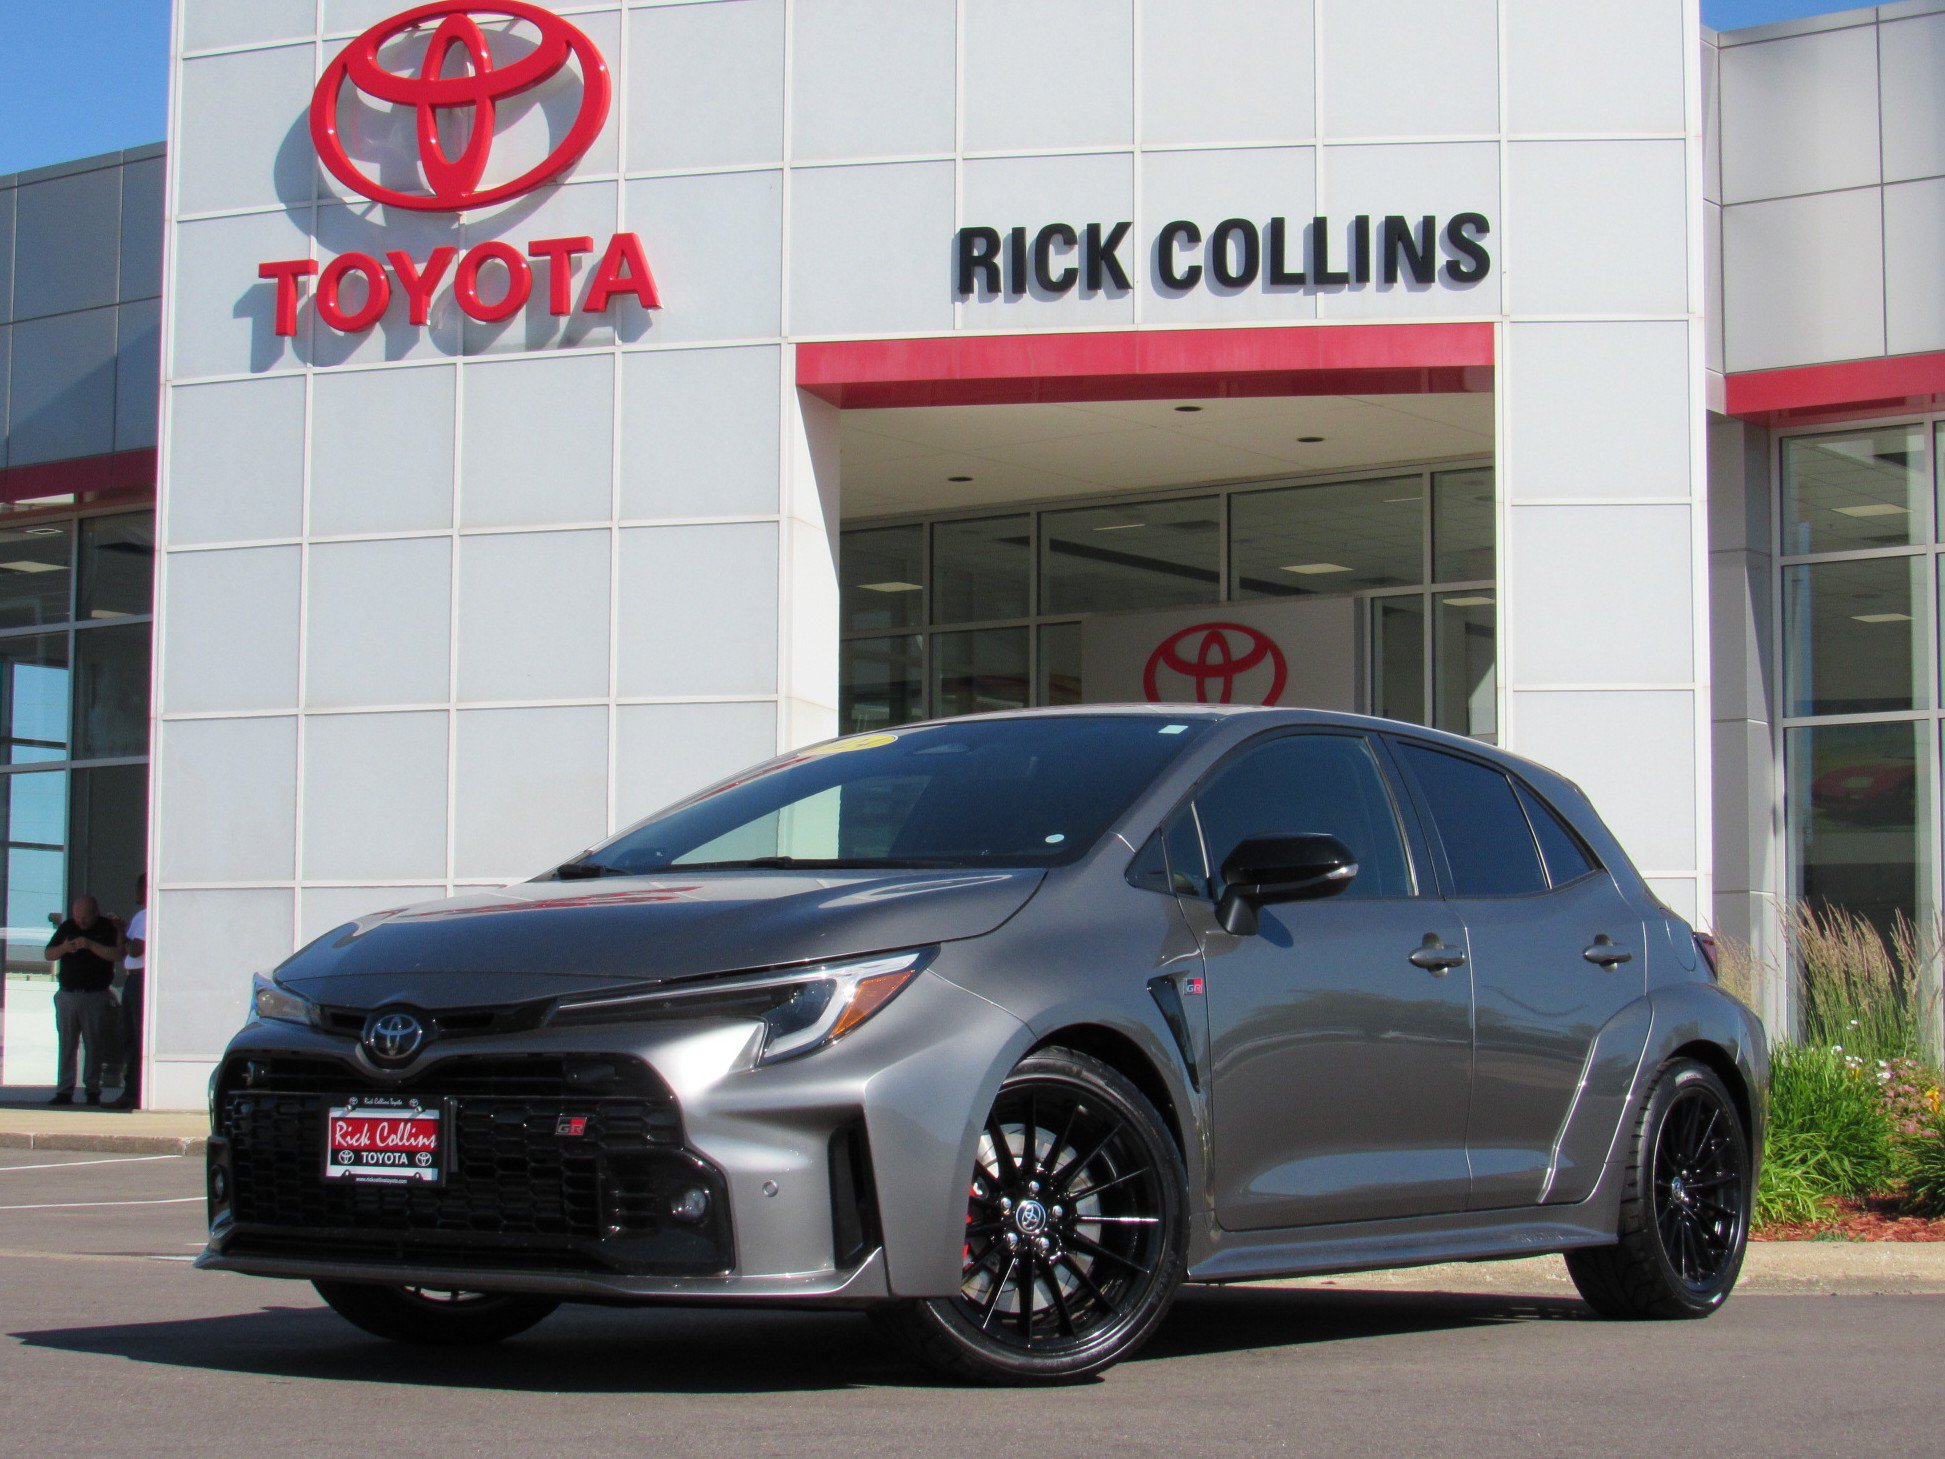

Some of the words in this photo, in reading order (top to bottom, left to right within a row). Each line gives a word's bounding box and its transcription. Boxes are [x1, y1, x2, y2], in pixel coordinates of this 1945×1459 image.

[958, 221, 1133, 295] RICK
[1157, 212, 1491, 291] COLLINS
[258, 232, 664, 337] TOYOTA
[335, 1121, 371, 1147] Rick
[376, 1121, 437, 1148] Collins
[361, 1151, 408, 1165] TOYOTA
